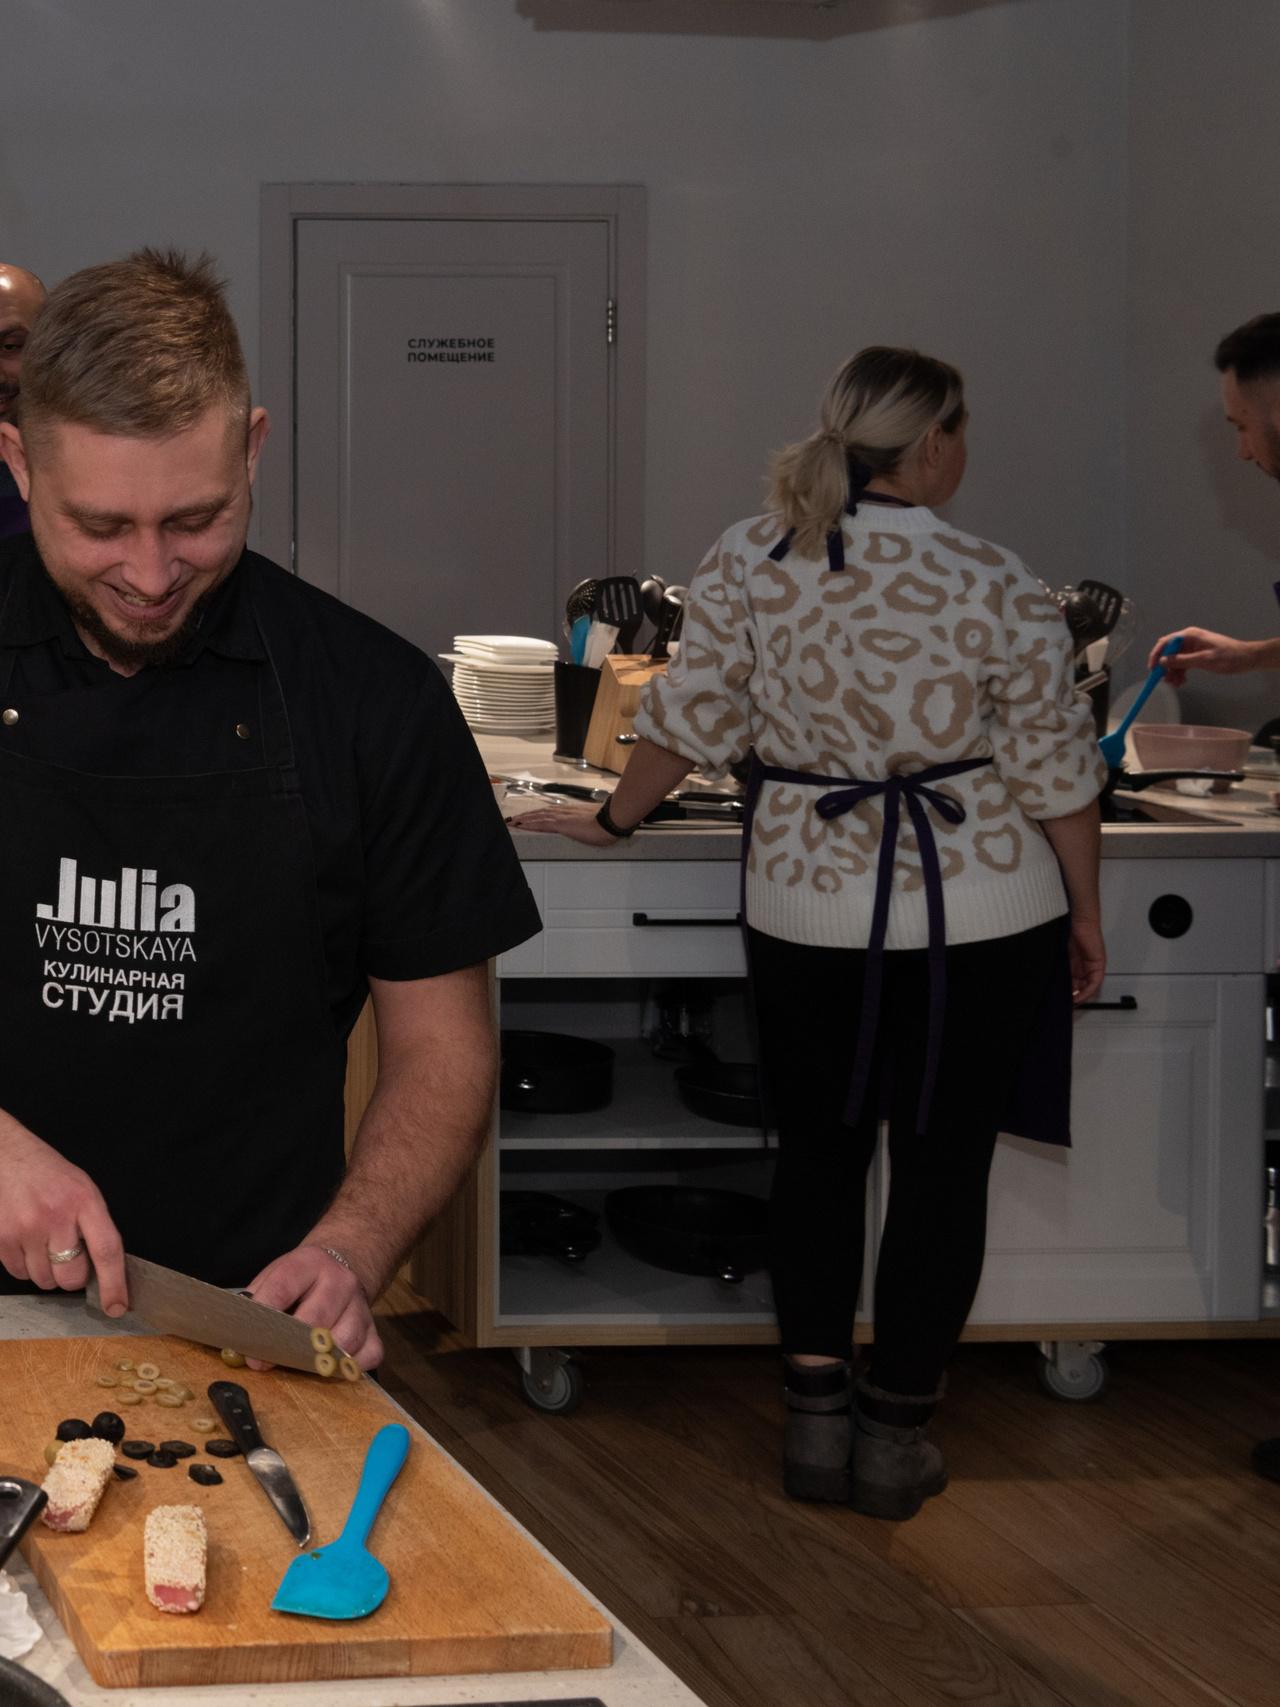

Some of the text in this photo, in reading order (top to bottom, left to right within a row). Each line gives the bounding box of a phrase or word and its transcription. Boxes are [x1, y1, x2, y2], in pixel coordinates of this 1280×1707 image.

[407, 338, 495, 349] СЛУЖЕБНОЕ
[407, 351, 495, 363] ПОМЕЩЕНИЕ
[36, 857, 196, 933] Julia
[35, 923, 197, 962] VYSOTSKAYA
[43, 959, 185, 990] КУЛИНАРНАЯ
[42, 981, 184, 1024] СТУДИЯ
